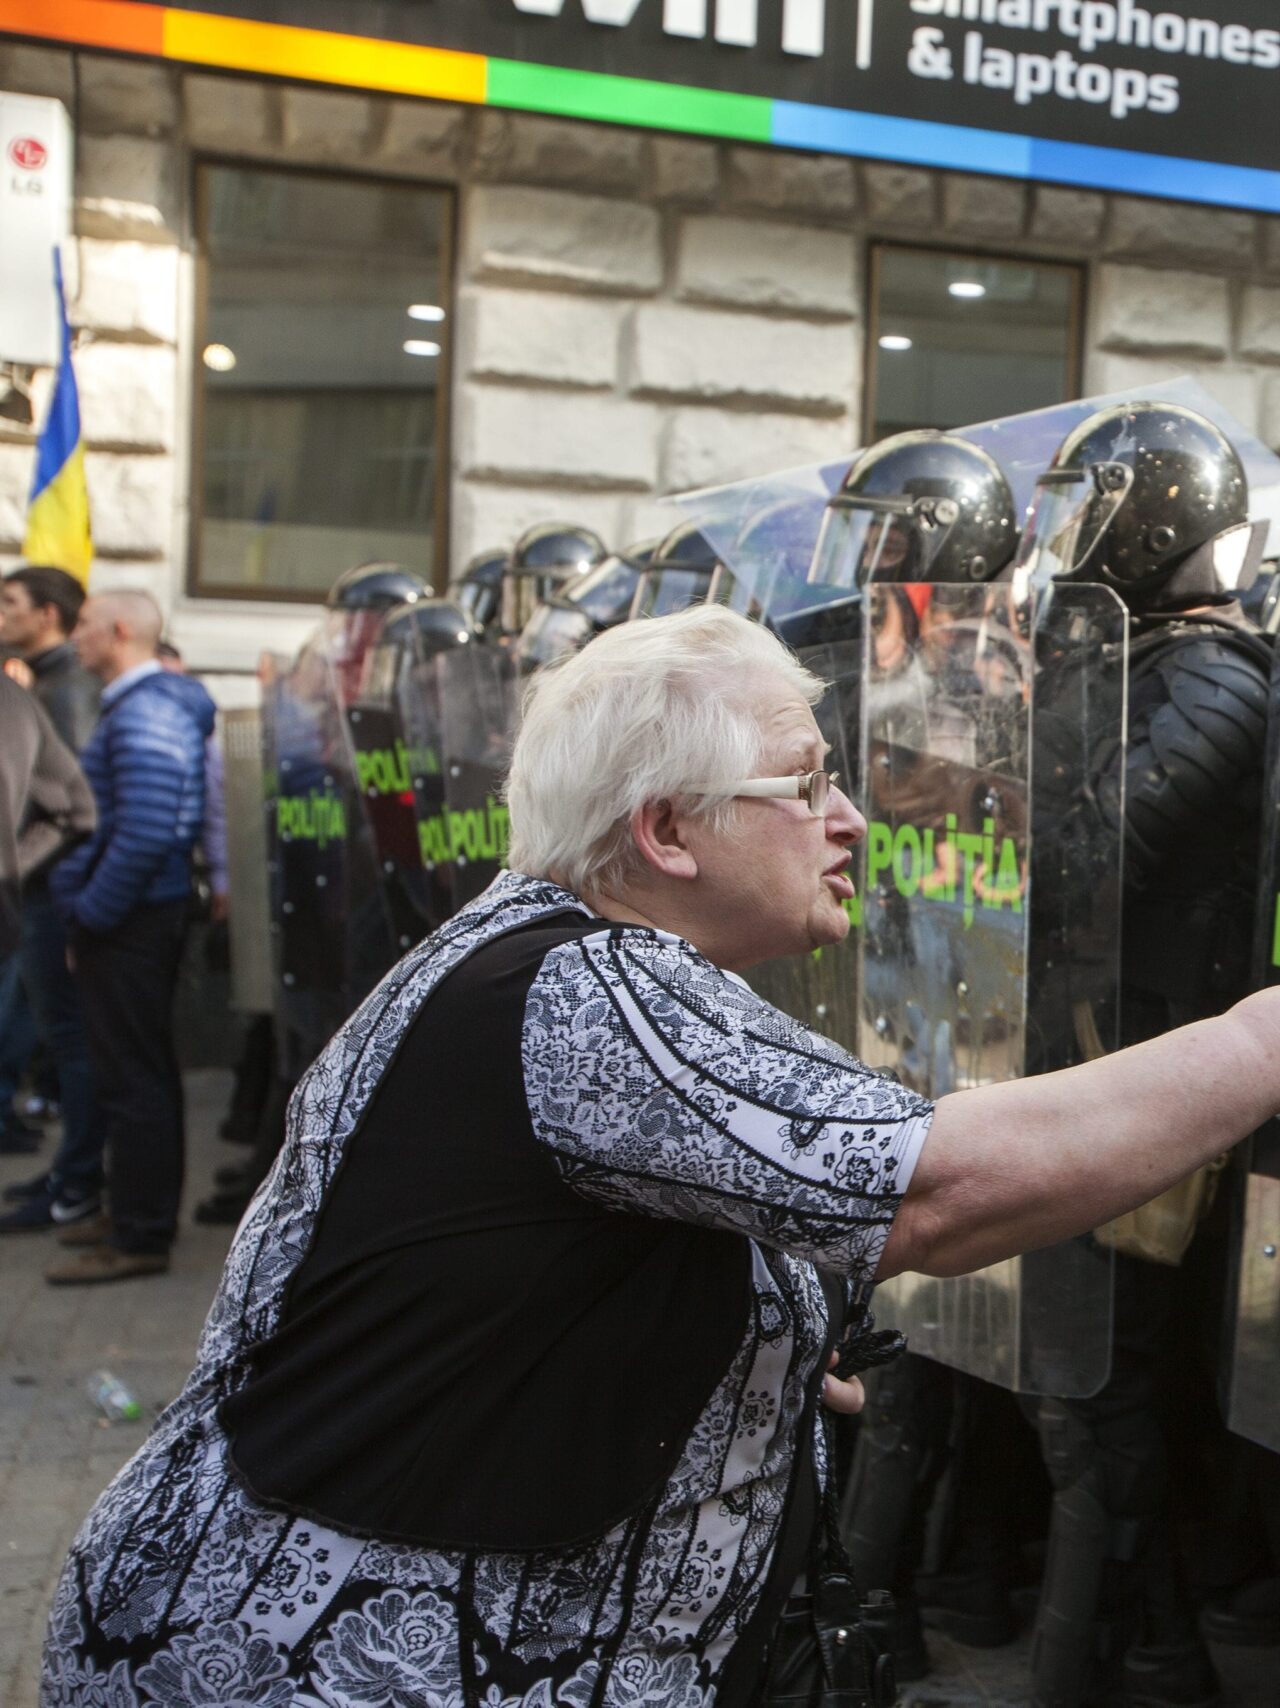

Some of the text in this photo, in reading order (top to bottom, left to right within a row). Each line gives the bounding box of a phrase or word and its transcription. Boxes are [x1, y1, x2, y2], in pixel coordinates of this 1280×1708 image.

[907, 26, 954, 80] &
[963, 31, 1180, 119] laptops
[10, 175, 43, 196] LG
